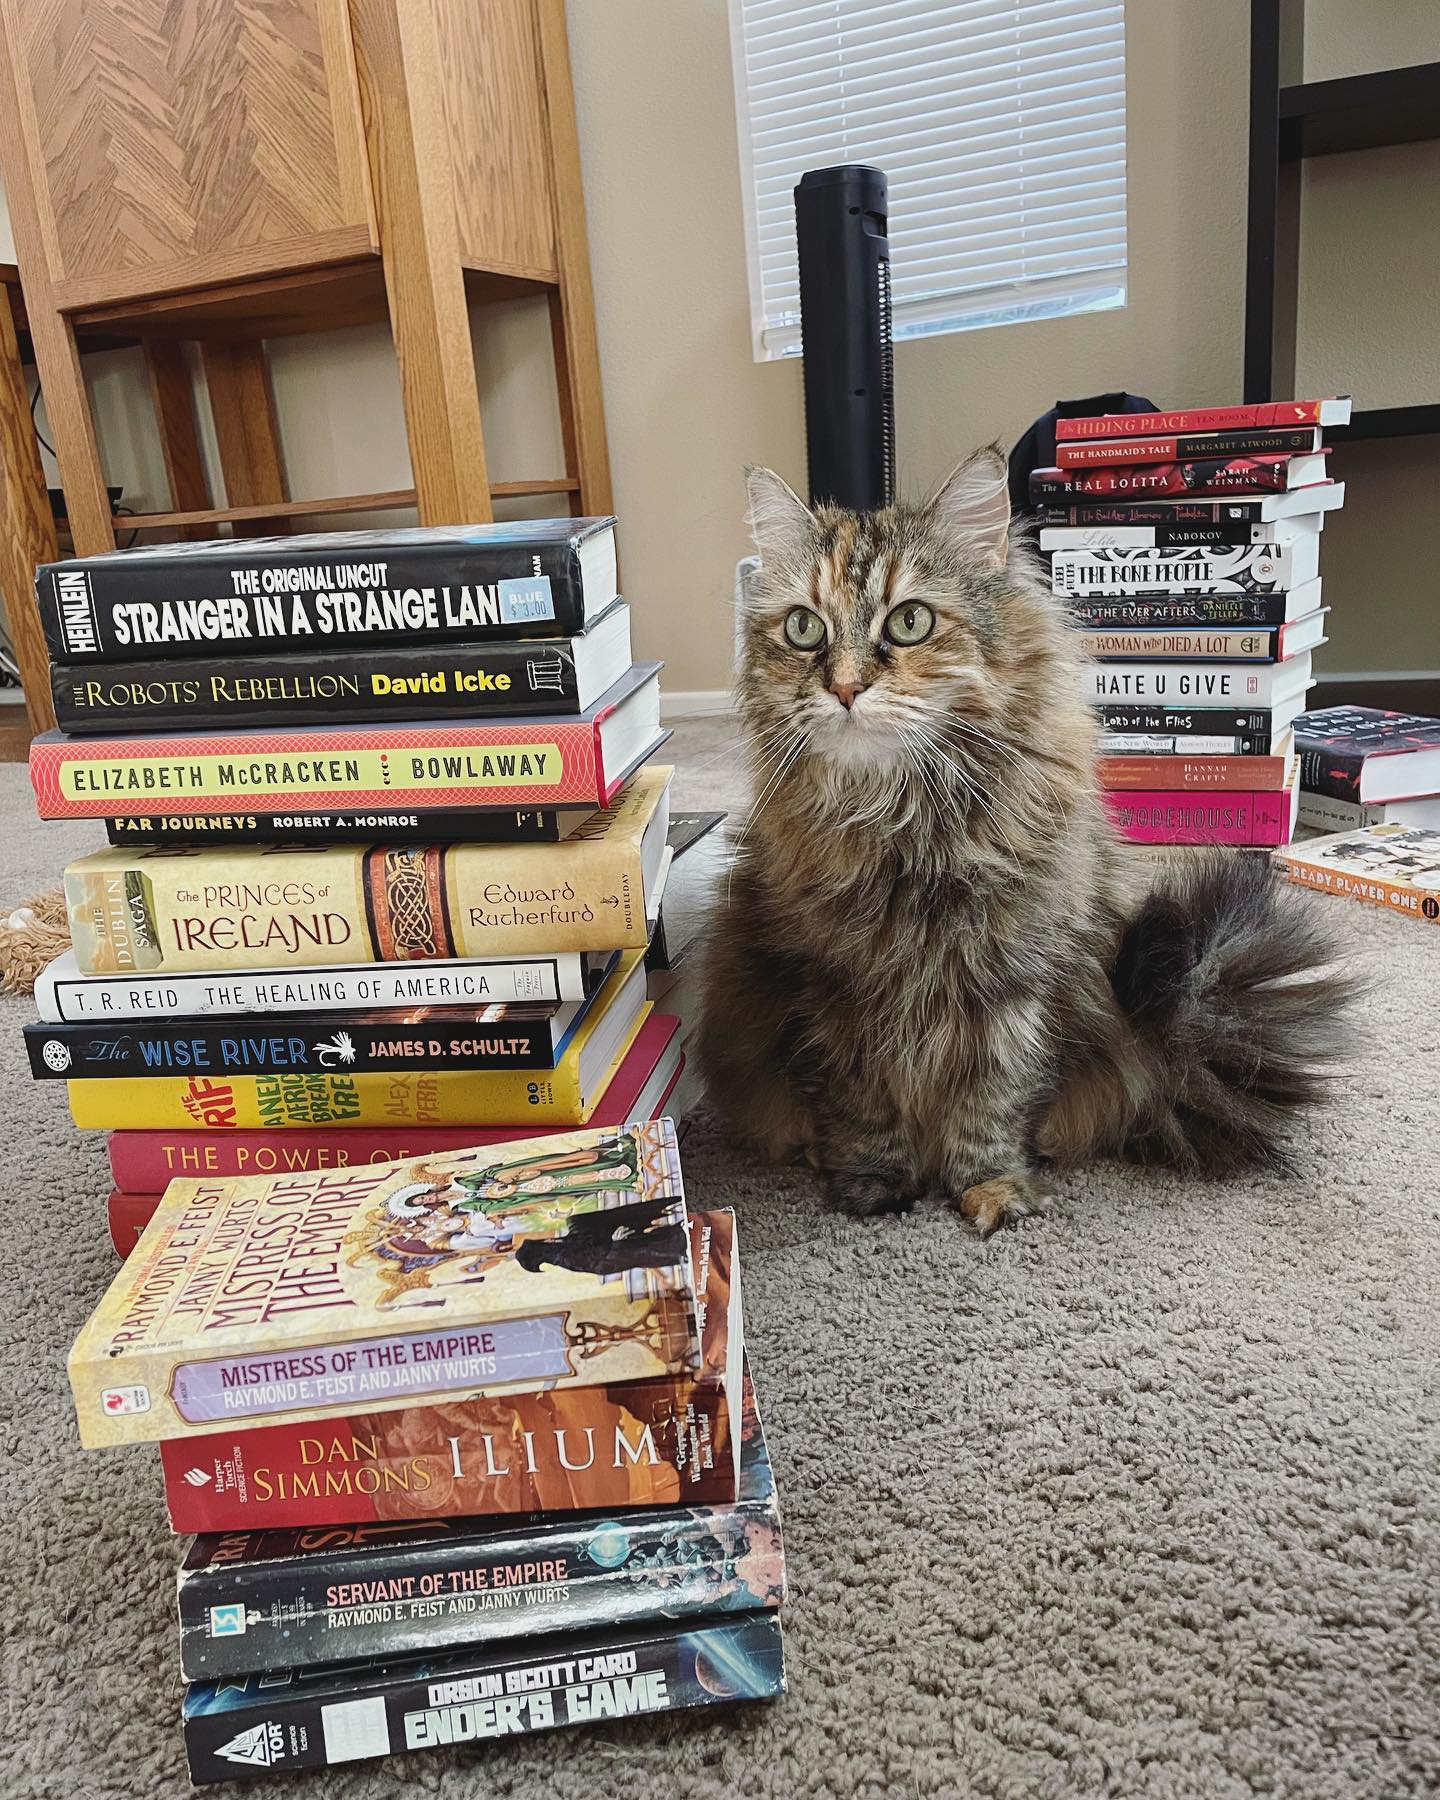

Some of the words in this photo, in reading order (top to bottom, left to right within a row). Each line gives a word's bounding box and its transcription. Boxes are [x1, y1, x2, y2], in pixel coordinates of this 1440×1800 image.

[1073, 420, 1135, 435] HIDING
[1141, 416, 1188, 430] PLACE
[1088, 447, 1145, 457] HANDMAID'S
[1149, 445, 1171, 453] TALE
[1186, 442, 1235, 451] MARGARET
[1240, 438, 1282, 448] ATWOOD
[1042, 484, 1057, 492] The
[1065, 481, 1102, 491] REAL
[1111, 477, 1168, 488] LOLITA
[1207, 477, 1258, 486] WEINMAN
[1168, 532, 1222, 541] NABOKOV
[231, 570, 261, 595] THE
[261, 565, 335, 594] ORIGINAL
[335, 563, 388, 589] UNCUT
[1077, 566, 1107, 584] THE
[1111, 565, 1152, 583] BONE
[1156, 562, 1213, 581] PEOPLE
[57, 571, 98, 653] HEINLEIN
[508, 591, 545, 604] BLUE
[1098, 608, 1118, 618] THE
[1122, 607, 1150, 618] EVER
[1154, 605, 1196, 617] AFTERS
[1203, 602, 1243, 610] DANIELLE
[112, 597, 252, 645] STRANGER
[253, 595, 287, 637] IN
[291, 594, 314, 635] A
[315, 587, 440, 634] STRANGE
[441, 583, 500, 627] LAN
[1096, 636, 1142, 650] WOMAN
[1163, 636, 1191, 652] DIED
[1193, 637, 1202, 652] A
[1206, 636, 1231, 653] LOT
[73, 683, 86, 708] THE
[86, 681, 201, 708] ROBOTS'
[210, 675, 360, 703] REBELLION
[371, 672, 446, 695] David
[455, 670, 511, 692] Icke
[1096, 675, 1145, 694] HATE
[1156, 675, 1166, 694] U
[1179, 675, 1231, 695] GIVE
[73, 766, 203, 791] ELIZABETH
[218, 760, 360, 786] McCRACKEN
[411, 754, 547, 779] BOWLAWAY
[1184, 764, 1227, 772] HANNAH
[1185, 773, 1226, 781] CRAFTS
[114, 818, 153, 831] FAR
[161, 817, 257, 830] JOURNEYS
[272, 817, 330, 828] ROBERT
[336, 816, 352, 827] A.
[355, 815, 418, 828] MONROE
[177, 890, 200, 903] The
[203, 882, 316, 912] PRINCES
[318, 886, 330, 897] of
[483, 881, 575, 905] Edward
[620, 872, 633, 930] DOUBLEDAY
[1293, 866, 1332, 887] READY
[1336, 877, 1385, 901] PLAYER
[1389, 891, 1418, 910] ONE
[93, 908, 105, 937] THE
[106, 878, 133, 966] DUBLIN
[128, 894, 150, 949] SAGA
[469, 903, 595, 927] Rutherfurd
[171, 913, 351, 954] IRELAND
[74, 993, 93, 1012] T.
[102, 992, 121, 1010] R.
[130, 989, 178, 1009] REID
[205, 986, 243, 1005] THE
[255, 982, 346, 1004] HEALING
[358, 980, 382, 999] OF
[394, 975, 491, 998] AMERICA
[85, 1035, 132, 1062] The
[139, 1039, 211, 1067] WISE
[220, 1037, 309, 1066] RIVER
[368, 1039, 425, 1058] JAMES
[429, 1041, 446, 1056] D.
[450, 1037, 531, 1056] SCHULTZ
[181, 1093, 203, 1121] THE
[188, 1075, 237, 1127] RIF
[384, 1075, 412, 1118] ALEX
[162, 1146, 218, 1170] THE
[237, 1148, 348, 1170] POWER
[178, 1187, 224, 1231] FEIST
[288, 1168, 402, 1261] EMPIRE
[169, 1234, 200, 1248] E.
[203, 1212, 302, 1331] MISTRESS
[266, 1180, 317, 1205] OF
[174, 1262, 229, 1315] JANNY
[206, 1199, 259, 1254] WURTS
[112, 1256, 187, 1343] RAYMOND
[261, 1261, 357, 1323] THE
[221, 1356, 326, 1388] MISTRESS
[332, 1351, 356, 1373] OF
[362, 1342, 406, 1369] THE
[412, 1333, 495, 1362] EMPIRE
[224, 1382, 297, 1409] RAYMOND
[300, 1381, 314, 1398] E.
[317, 1376, 356, 1396] FEIST
[359, 1373, 390, 1393] AND
[393, 1365, 444, 1391] JANNY
[444, 1355, 496, 1378] WURTS
[233, 1446, 243, 1472] FICTION
[299, 1434, 379, 1465] DAN
[447, 1423, 662, 1479] ILIUM
[215, 1458, 224, 1493] Harper
[223, 1461, 234, 1490] Torch
[236, 1474, 247, 1503] SCIENCE
[253, 1457, 431, 1502] SIMMONS
[326, 1577, 415, 1608] SERVANT
[420, 1574, 445, 1596] OF
[448, 1569, 488, 1594] THE
[492, 1559, 567, 1588] EMPIRE
[328, 1607, 391, 1628] RAYMOND
[395, 1605, 407, 1621] E.
[411, 1602, 445, 1618] FEIST
[449, 1598, 476, 1614] AND
[478, 1591, 521, 1612] JANNY
[525, 1586, 570, 1604] WURTS
[427, 1672, 503, 1707] ORSON
[505, 1661, 576, 1693] SCOTT
[578, 1650, 637, 1681] CARD
[404, 1692, 554, 1750] ENDER'S
[565, 1671, 670, 1723] GAME
